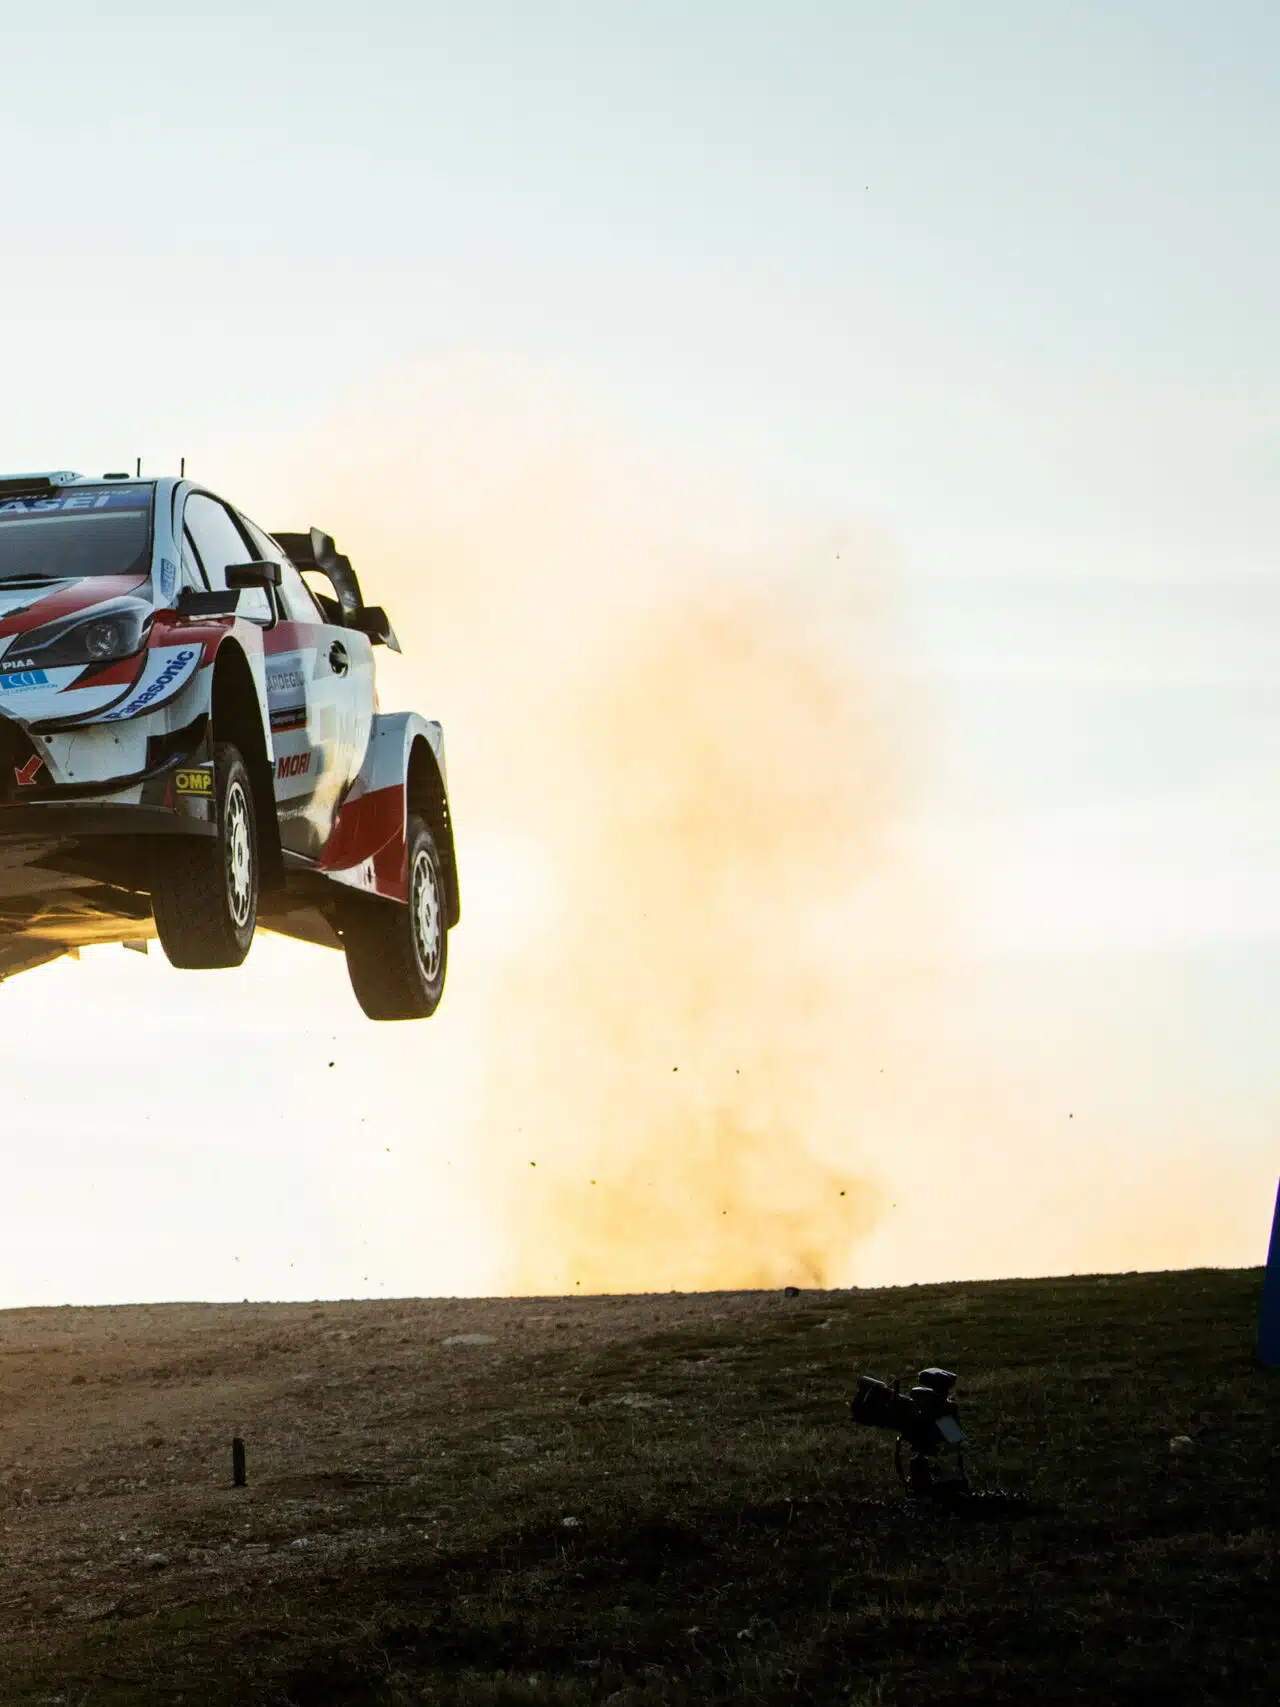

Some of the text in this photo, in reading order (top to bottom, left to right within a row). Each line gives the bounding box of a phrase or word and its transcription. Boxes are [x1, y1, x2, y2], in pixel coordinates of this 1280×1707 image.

[2, 658, 36, 671] PIAA
[103, 650, 195, 719] Panasonic
[277, 752, 311, 780] MORI
[175, 773, 212, 790] OMP
